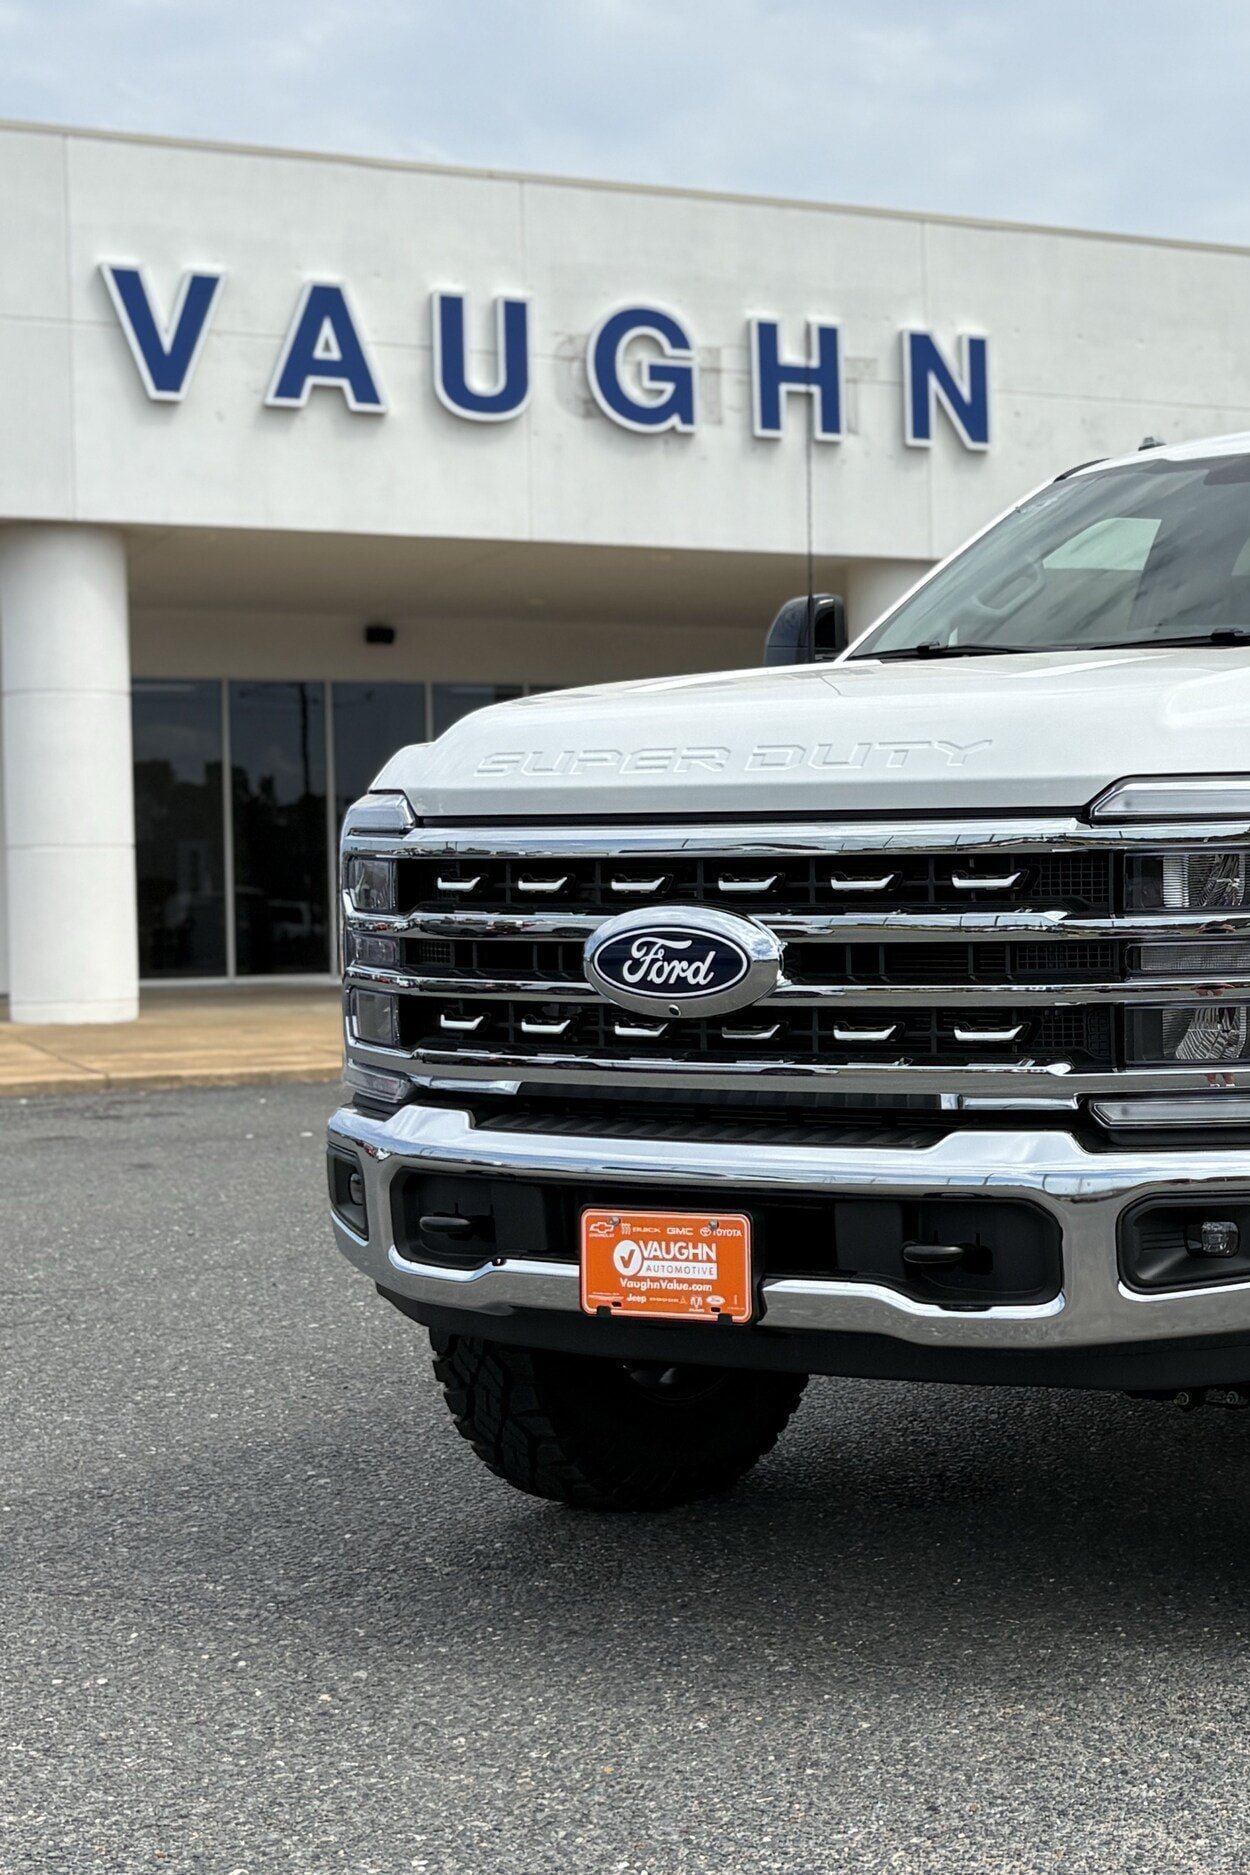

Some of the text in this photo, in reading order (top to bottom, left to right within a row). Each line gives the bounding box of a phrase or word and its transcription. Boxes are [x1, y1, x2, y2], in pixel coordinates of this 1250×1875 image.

[98, 261, 993, 454] VAUGHN
[472, 739, 994, 777] SUPER DUTY
[622, 936, 717, 985] Ford
[632, 1226, 661, 1234] BUICK
[666, 1227, 694, 1236] GMC
[712, 1228, 742, 1238] TOYOTA
[639, 1240, 717, 1262] VAUGHN
[645, 1264, 714, 1277] AUTOMOTIVE
[619, 1277, 713, 1292] VaughnValue.com
[626, 1293, 647, 1304] Jeep
